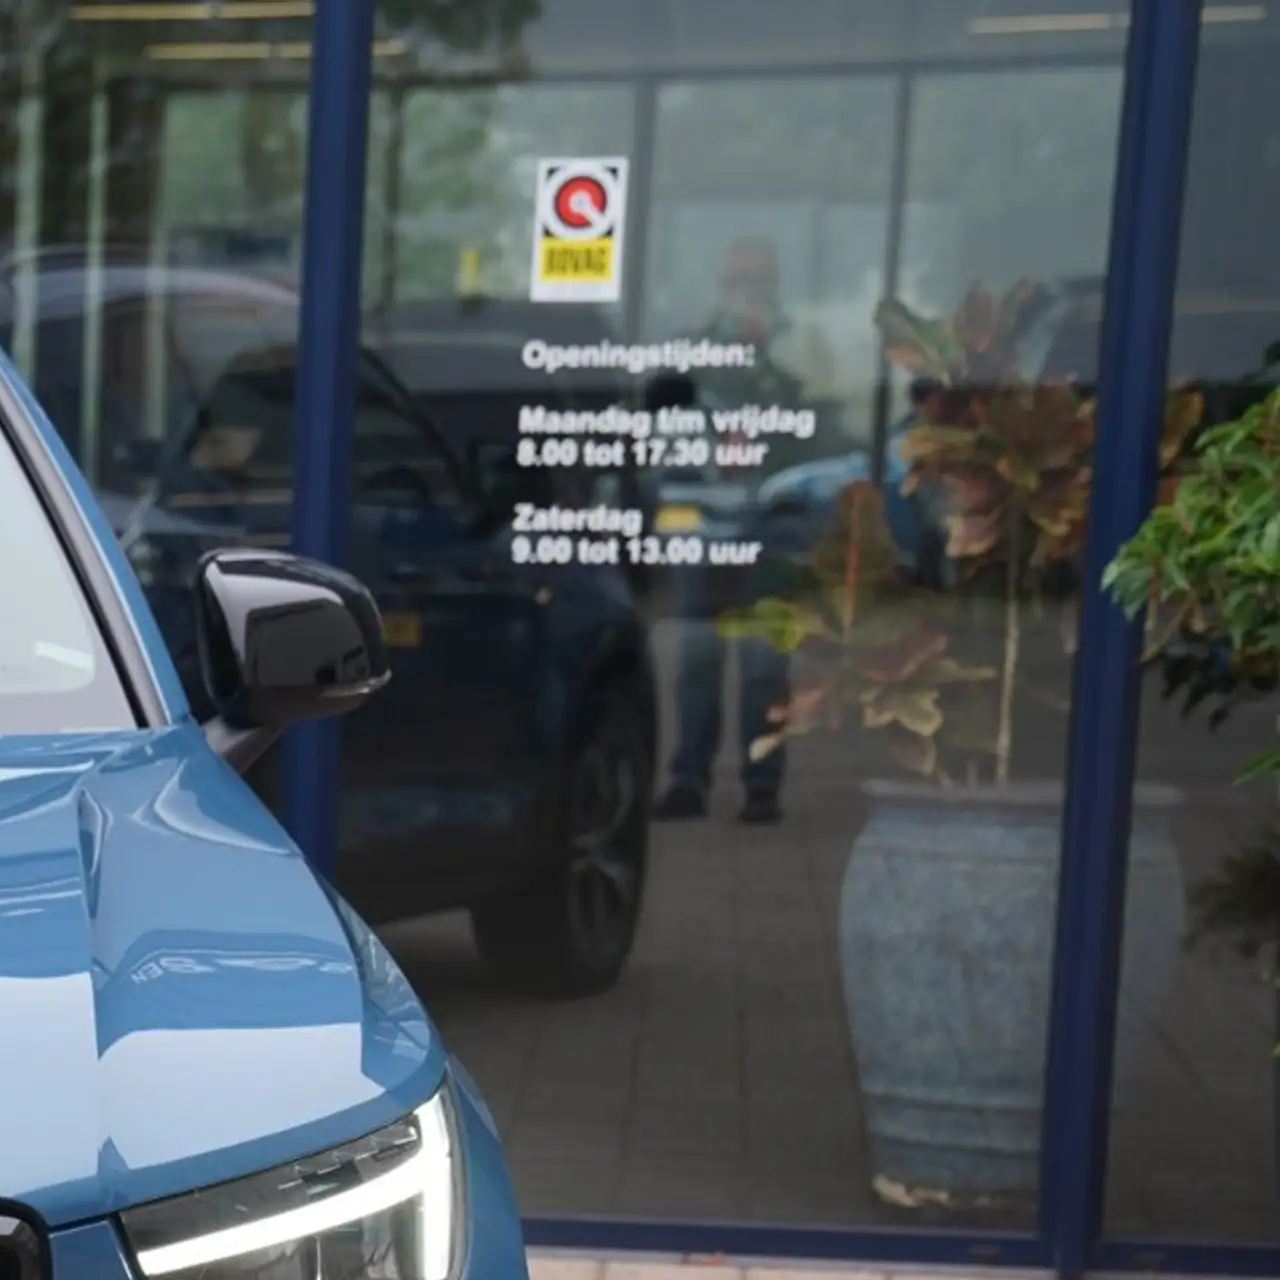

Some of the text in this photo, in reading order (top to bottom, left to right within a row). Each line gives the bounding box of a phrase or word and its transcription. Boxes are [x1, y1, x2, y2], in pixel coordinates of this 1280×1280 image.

[522, 339, 755, 374] Openingstijden:
[518, 404, 817, 439] Maandag t/m vrijdag
[516, 438, 770, 467] 8.00 tot 17.30 uur
[512, 503, 643, 537] Zaterdag
[511, 535, 763, 565] 9.00 tot 13.00 uur
